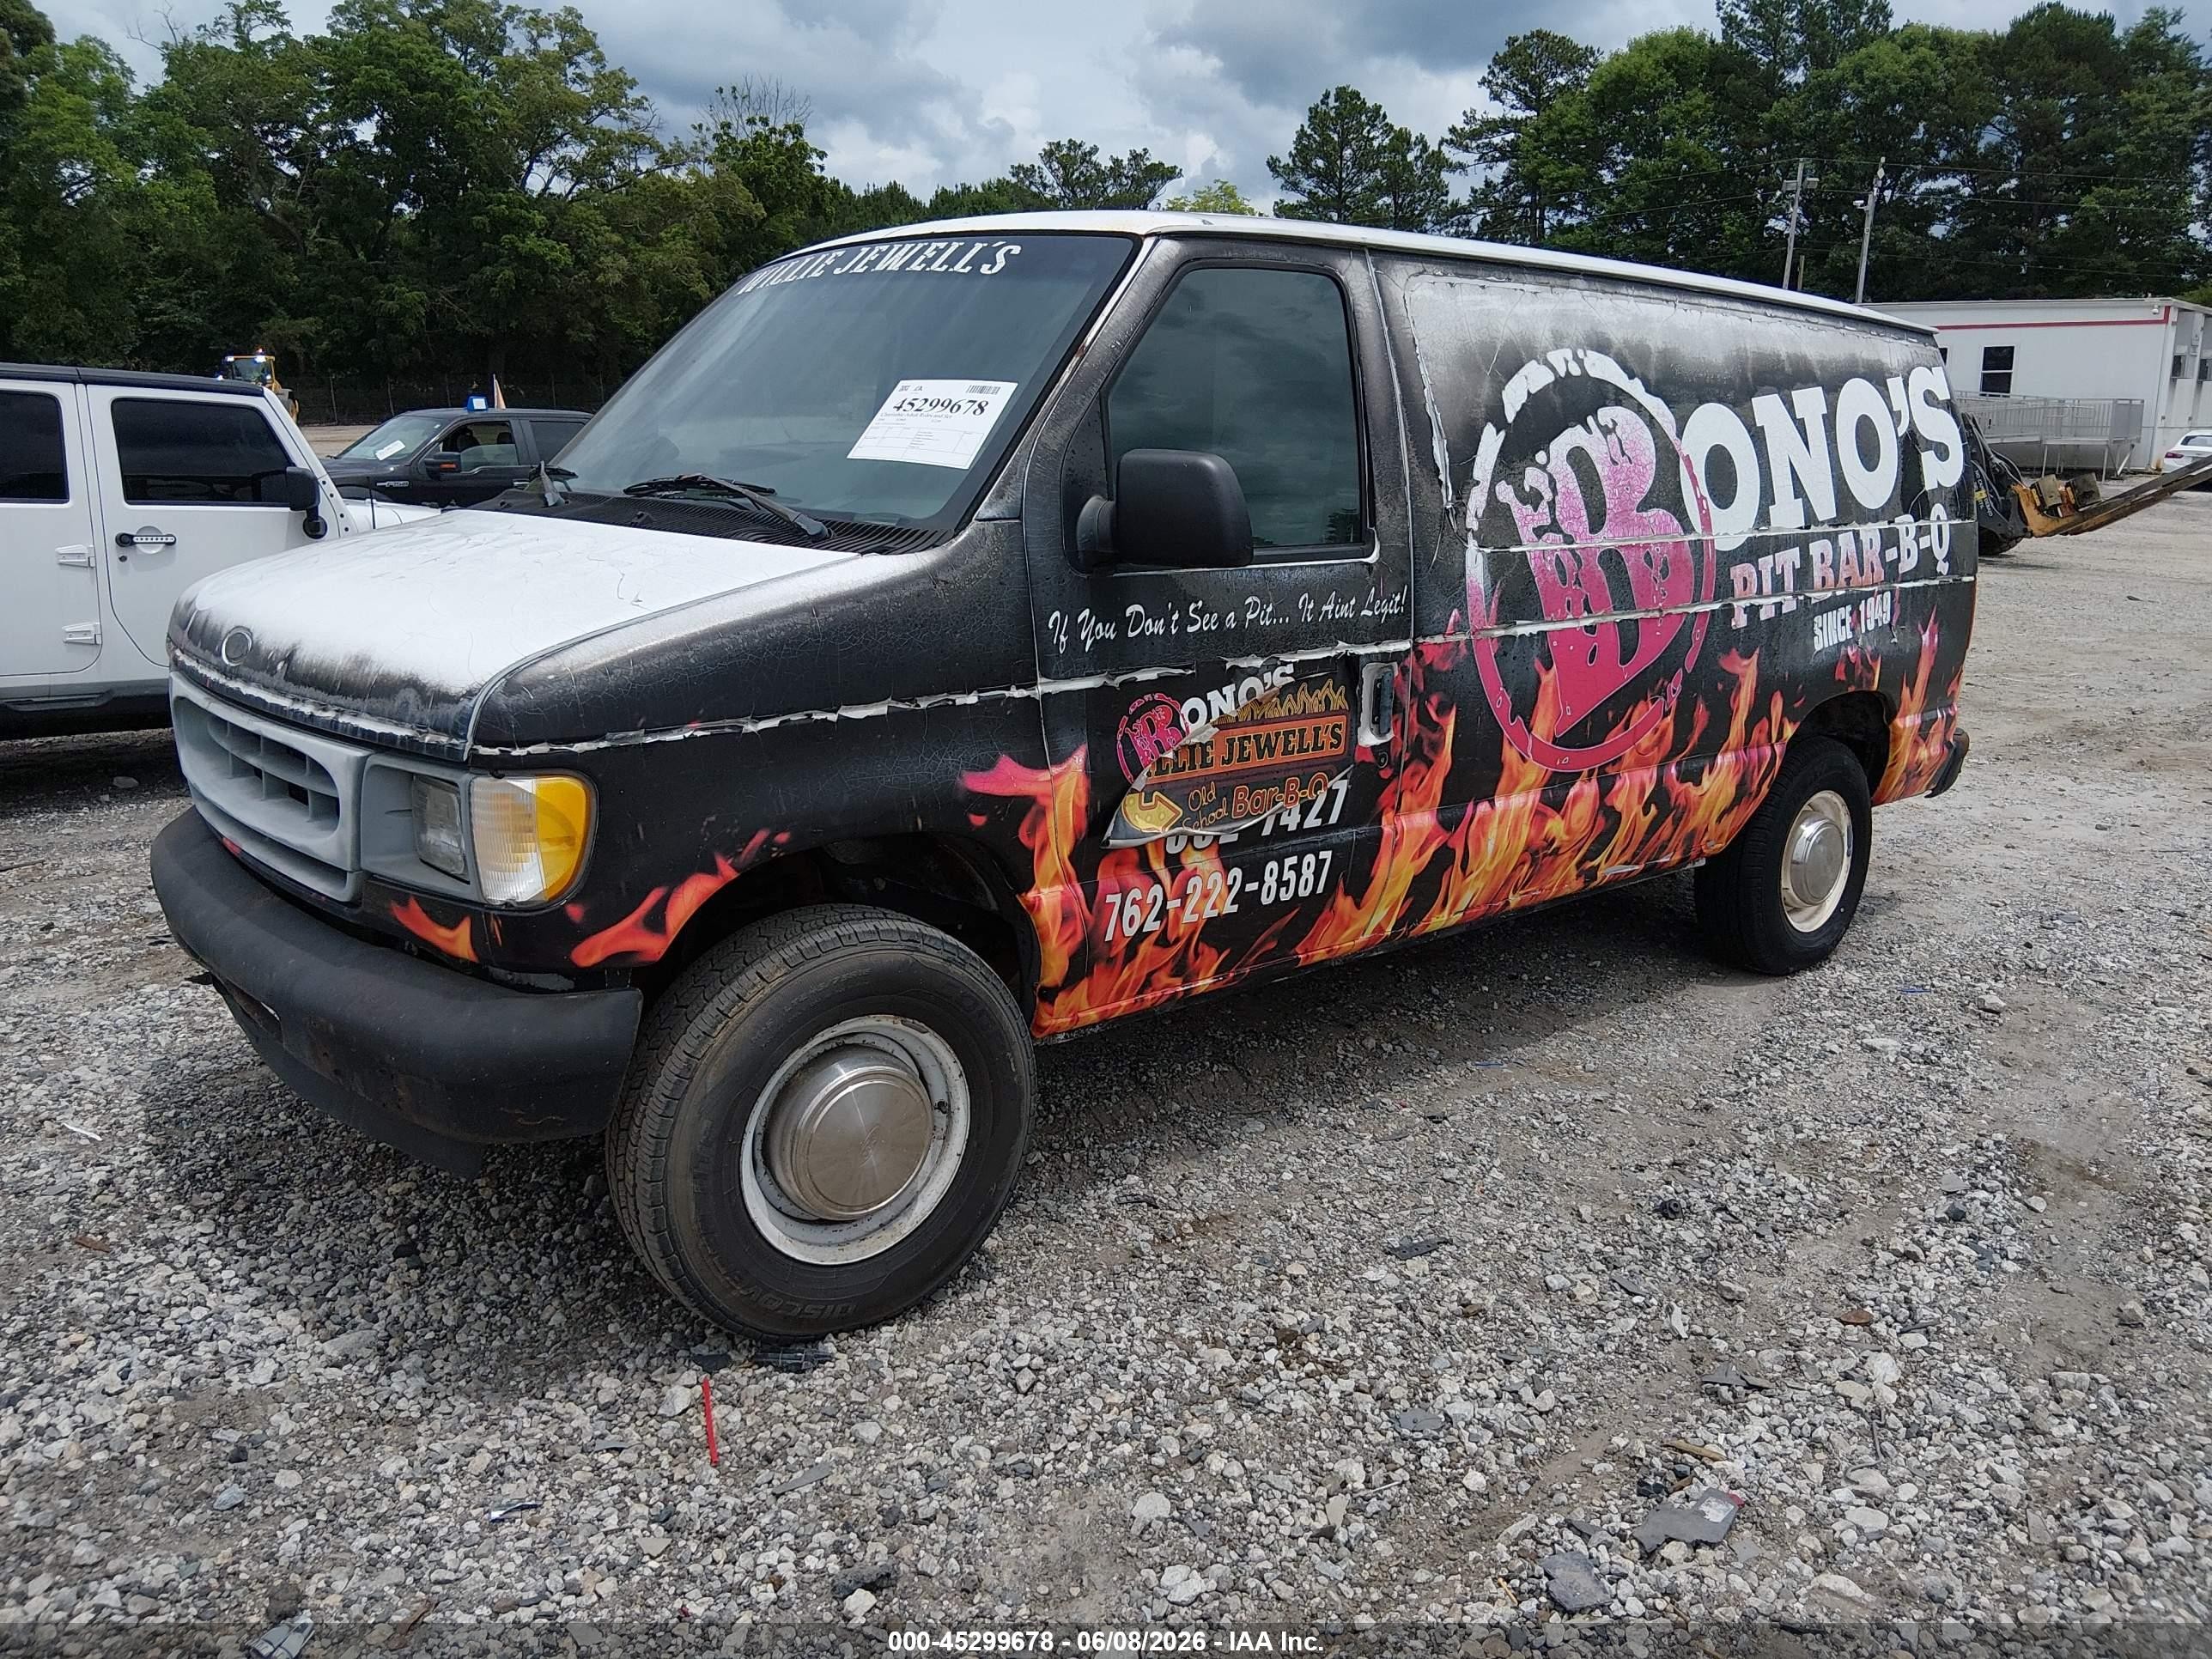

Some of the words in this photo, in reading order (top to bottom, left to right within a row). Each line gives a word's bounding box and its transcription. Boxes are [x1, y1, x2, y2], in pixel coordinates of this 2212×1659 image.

[735, 249, 845, 296] WILLIE
[832, 241, 1023, 275] JEWELL'S
[892, 398, 989, 416] 45299678
[1729, 546, 1802, 630] PIT
[1808, 501, 1951, 604] BAR-B-Q
[1048, 611, 1069, 654] If
[1077, 608, 1116, 653] You
[1125, 602, 1180, 638] Don't
[1186, 599, 1219, 634] See
[1225, 611, 1237, 629] a
[1243, 595, 1290, 632] Pit...
[1297, 592, 1314, 623] It
[1318, 591, 1356, 623] Aint
[1360, 586, 1408, 624] Legit!
[1813, 604, 1853, 652] SINCE
[1858, 591, 1892, 635] 1949
[1221, 721, 1345, 765] JEWELL'S
[1182, 796, 1229, 831] School
[1188, 781, 1216, 812] Old
[1104, 850, 1332, 943] 762-222-8587
